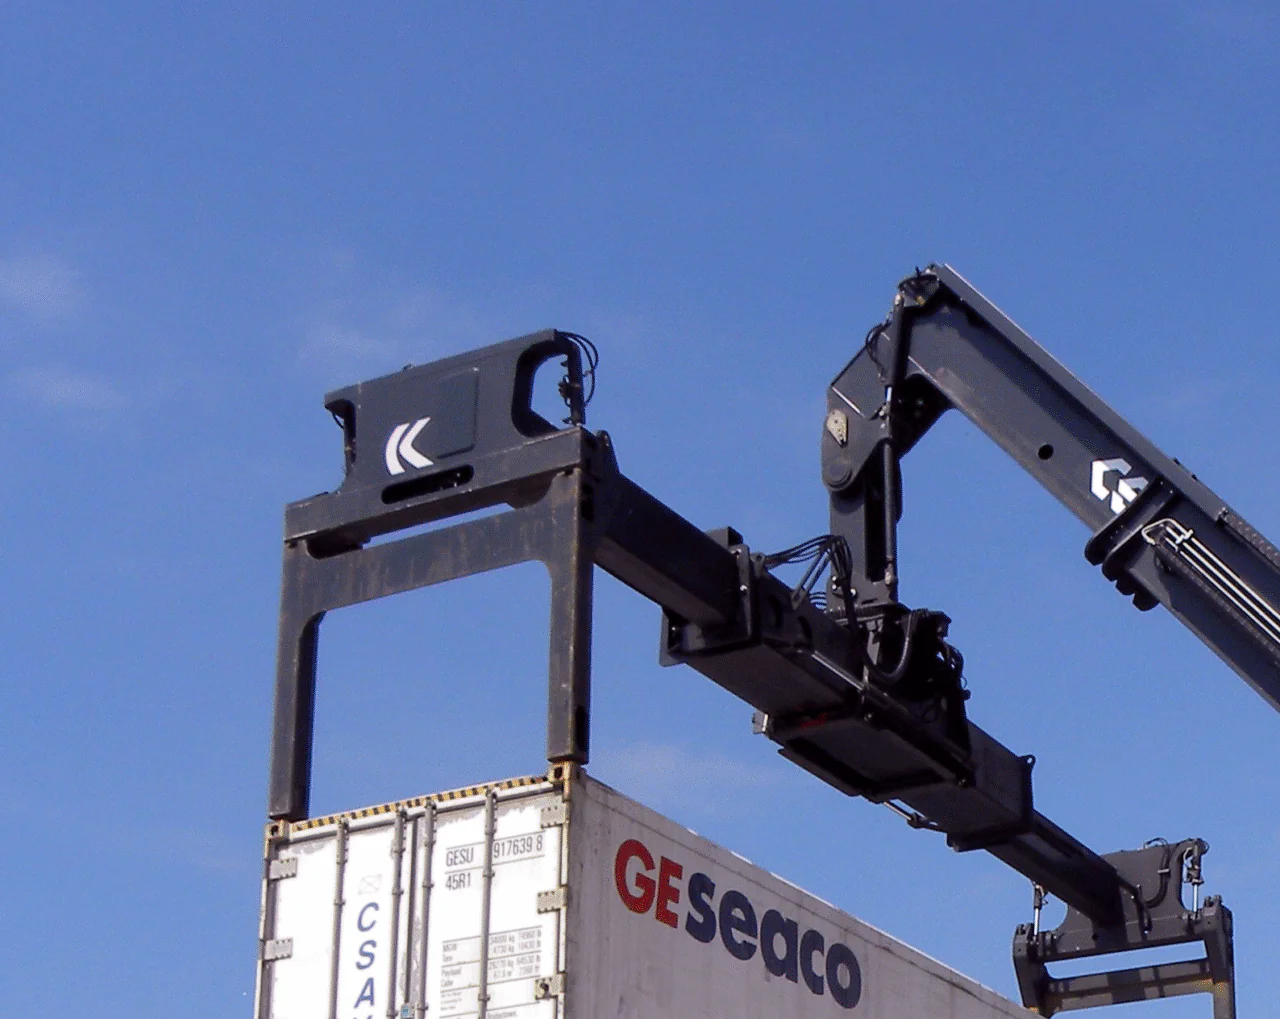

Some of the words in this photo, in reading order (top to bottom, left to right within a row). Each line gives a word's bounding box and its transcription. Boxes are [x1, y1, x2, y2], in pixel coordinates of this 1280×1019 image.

[446, 847, 474, 867] GESU
[493, 836, 533, 859] 917639
[536, 834, 543, 852] 8
[445, 872, 472, 892] 45R1
